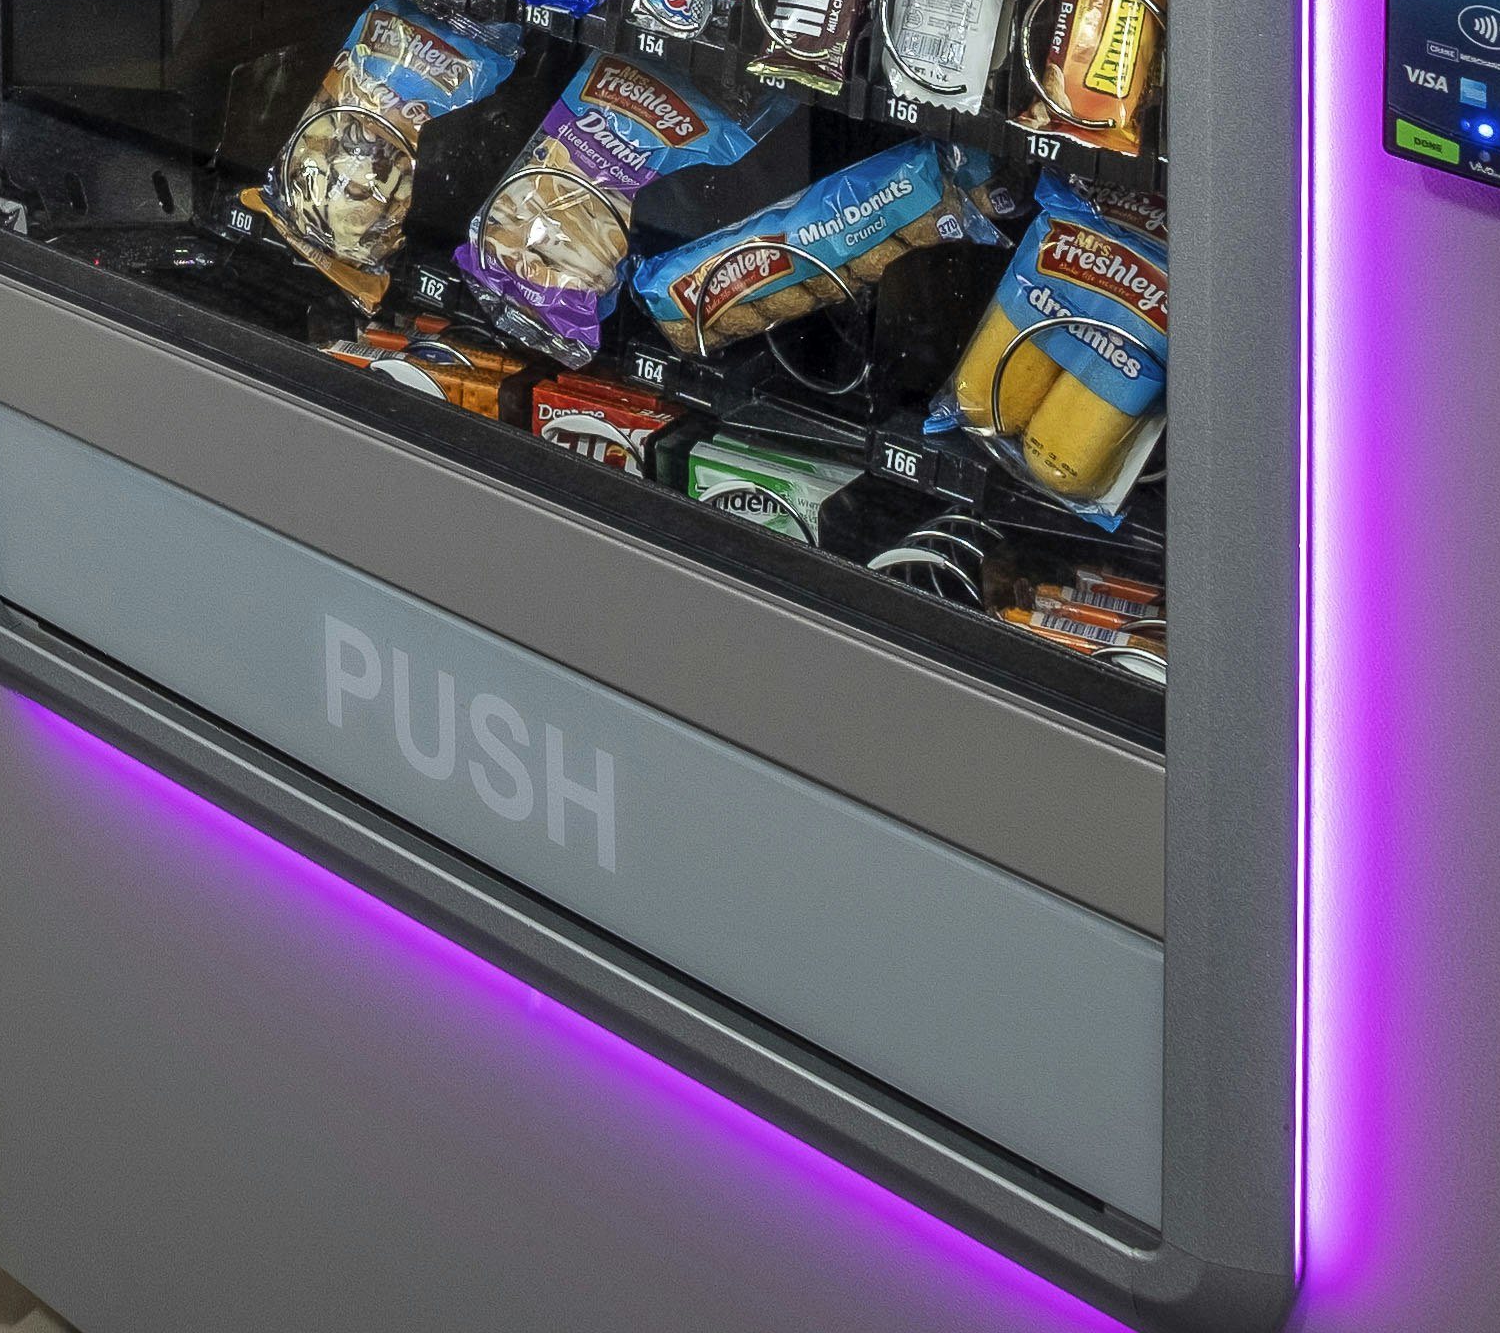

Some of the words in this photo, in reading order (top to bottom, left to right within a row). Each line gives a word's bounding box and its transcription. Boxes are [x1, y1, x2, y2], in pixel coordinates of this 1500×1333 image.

[638, 34, 664, 56] 154
[1402, 64, 1449, 94] VISA
[597, 65, 696, 137] Freshley's
[887, 98, 918, 123] 156
[576, 110, 651, 171] Danish
[1027, 135, 1061, 161] 157
[798, 209, 843, 246] Mini
[845, 175, 914, 225] Donuts
[1075, 231, 1114, 259] Mrs.
[635, 357, 663, 381] 164
[885, 448, 917, 476] 166
[325, 612, 616, 874] PUSH
